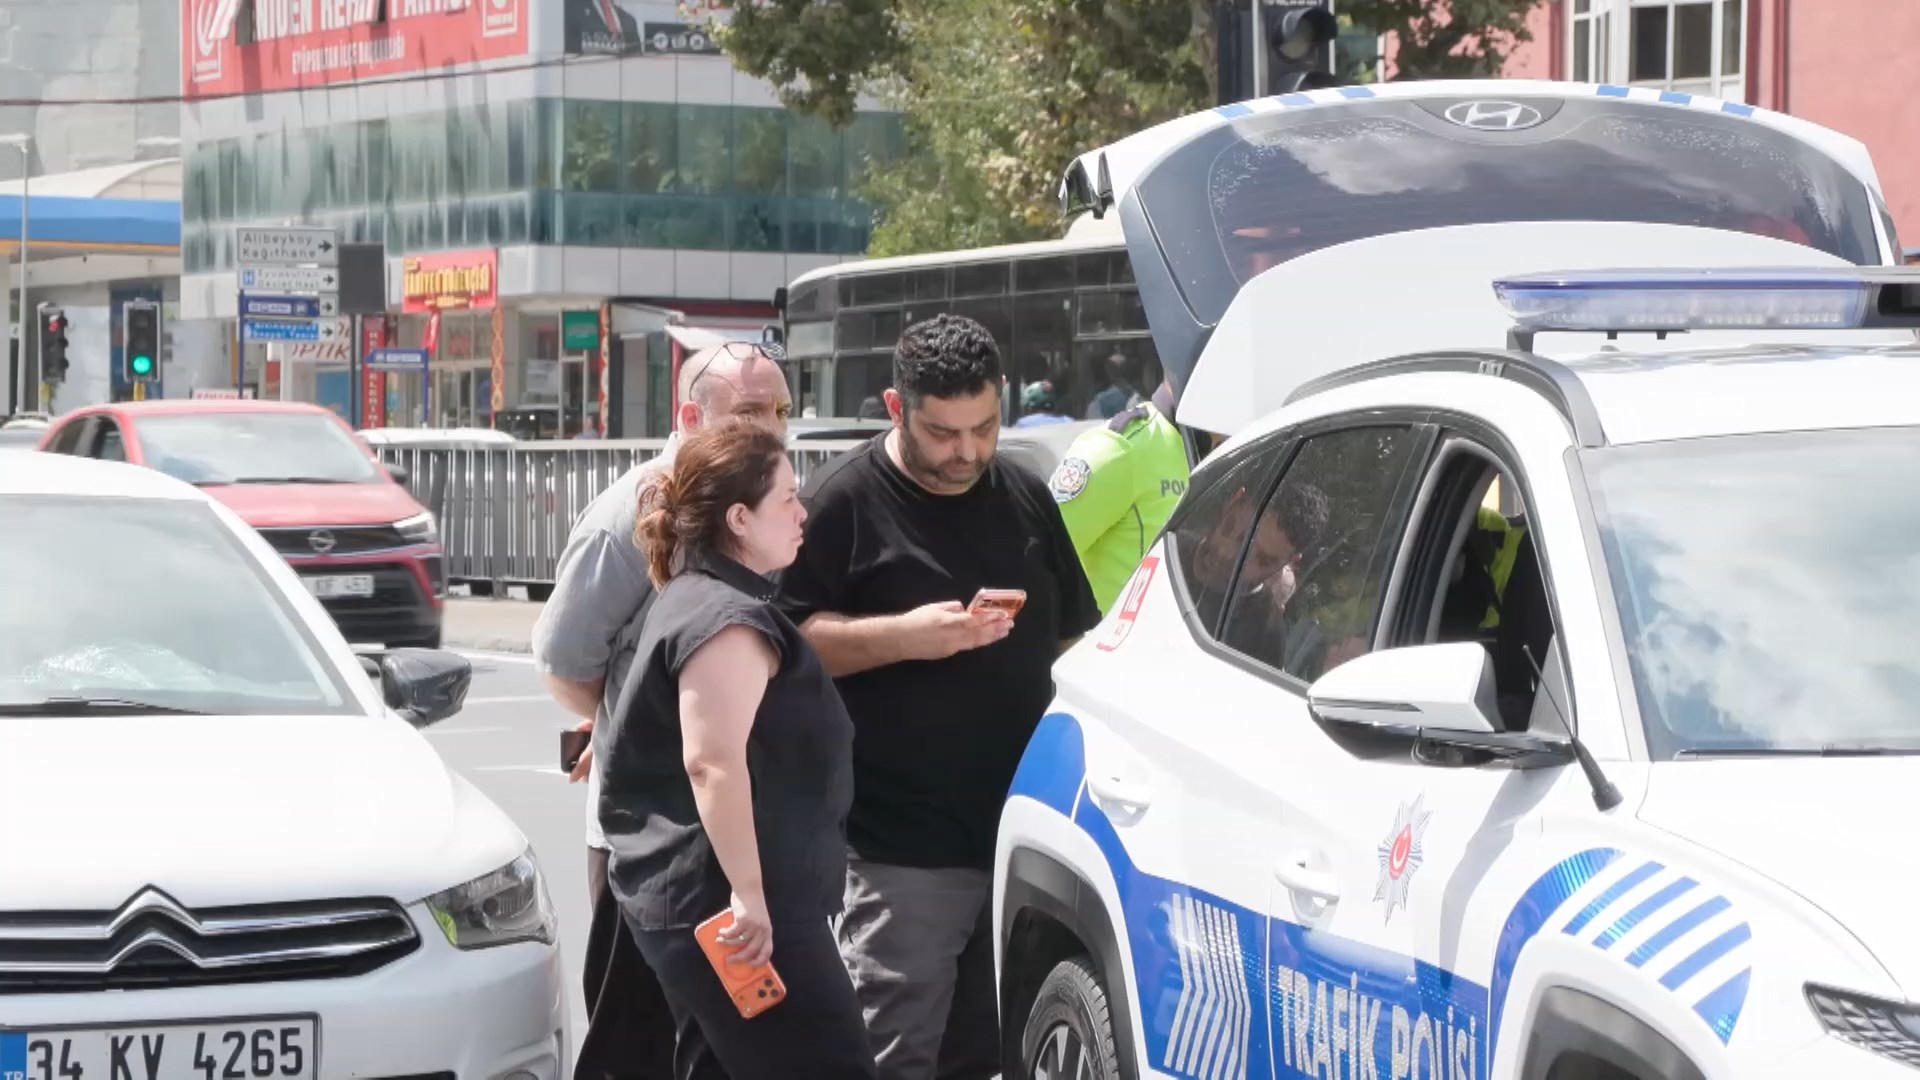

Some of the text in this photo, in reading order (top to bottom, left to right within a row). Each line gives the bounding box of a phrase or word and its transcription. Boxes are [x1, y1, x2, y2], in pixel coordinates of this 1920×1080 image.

[28, 1038, 83, 1080] 34
[193, 1027, 303, 1080] 4265
[1278, 964, 1382, 1080] TRAFİK
